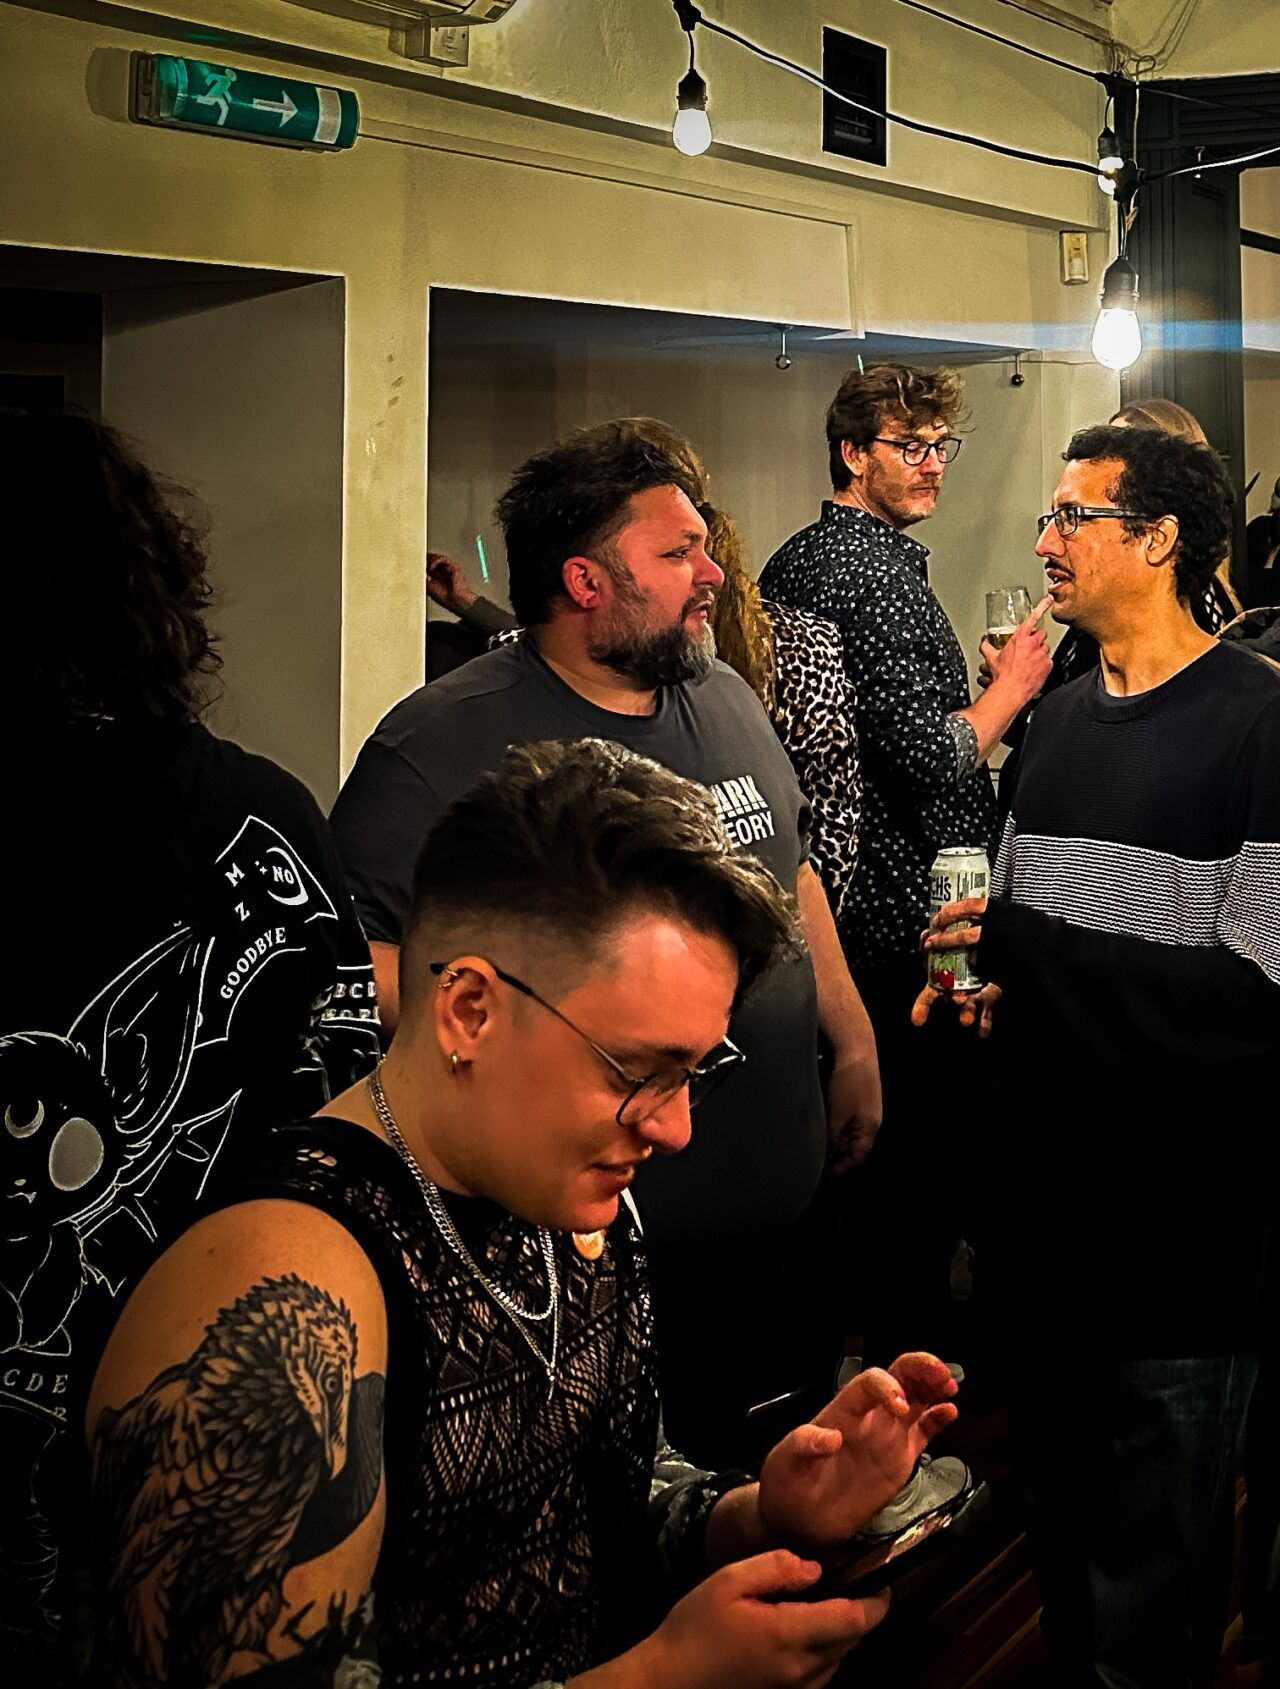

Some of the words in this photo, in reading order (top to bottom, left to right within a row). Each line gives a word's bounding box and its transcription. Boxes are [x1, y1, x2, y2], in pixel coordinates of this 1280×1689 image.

[225, 862, 245, 887] M
[272, 866, 295, 884] NO
[234, 901, 250, 922] Z
[220, 927, 286, 999] GOODBYE
